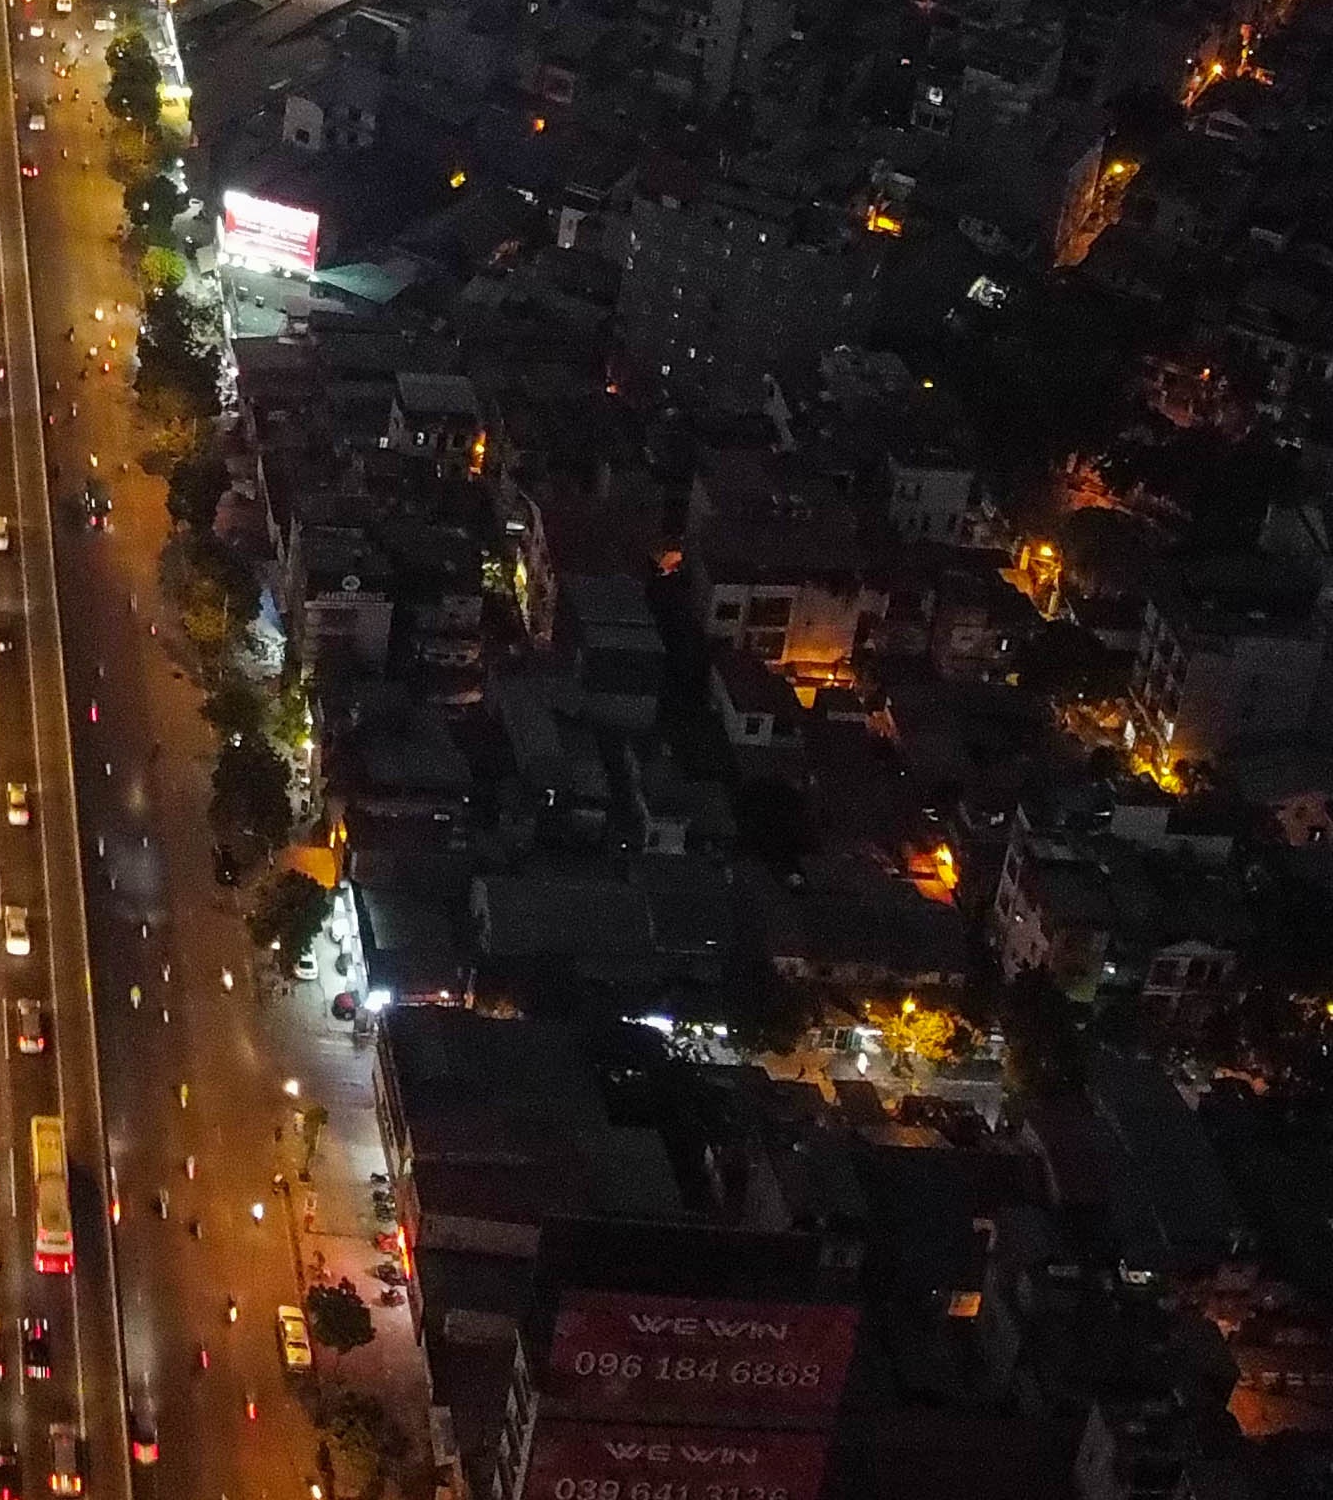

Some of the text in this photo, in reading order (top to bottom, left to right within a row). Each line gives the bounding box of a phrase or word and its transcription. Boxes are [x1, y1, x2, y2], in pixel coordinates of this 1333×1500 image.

[574, 1351, 821, 1387] 096 184 6868
